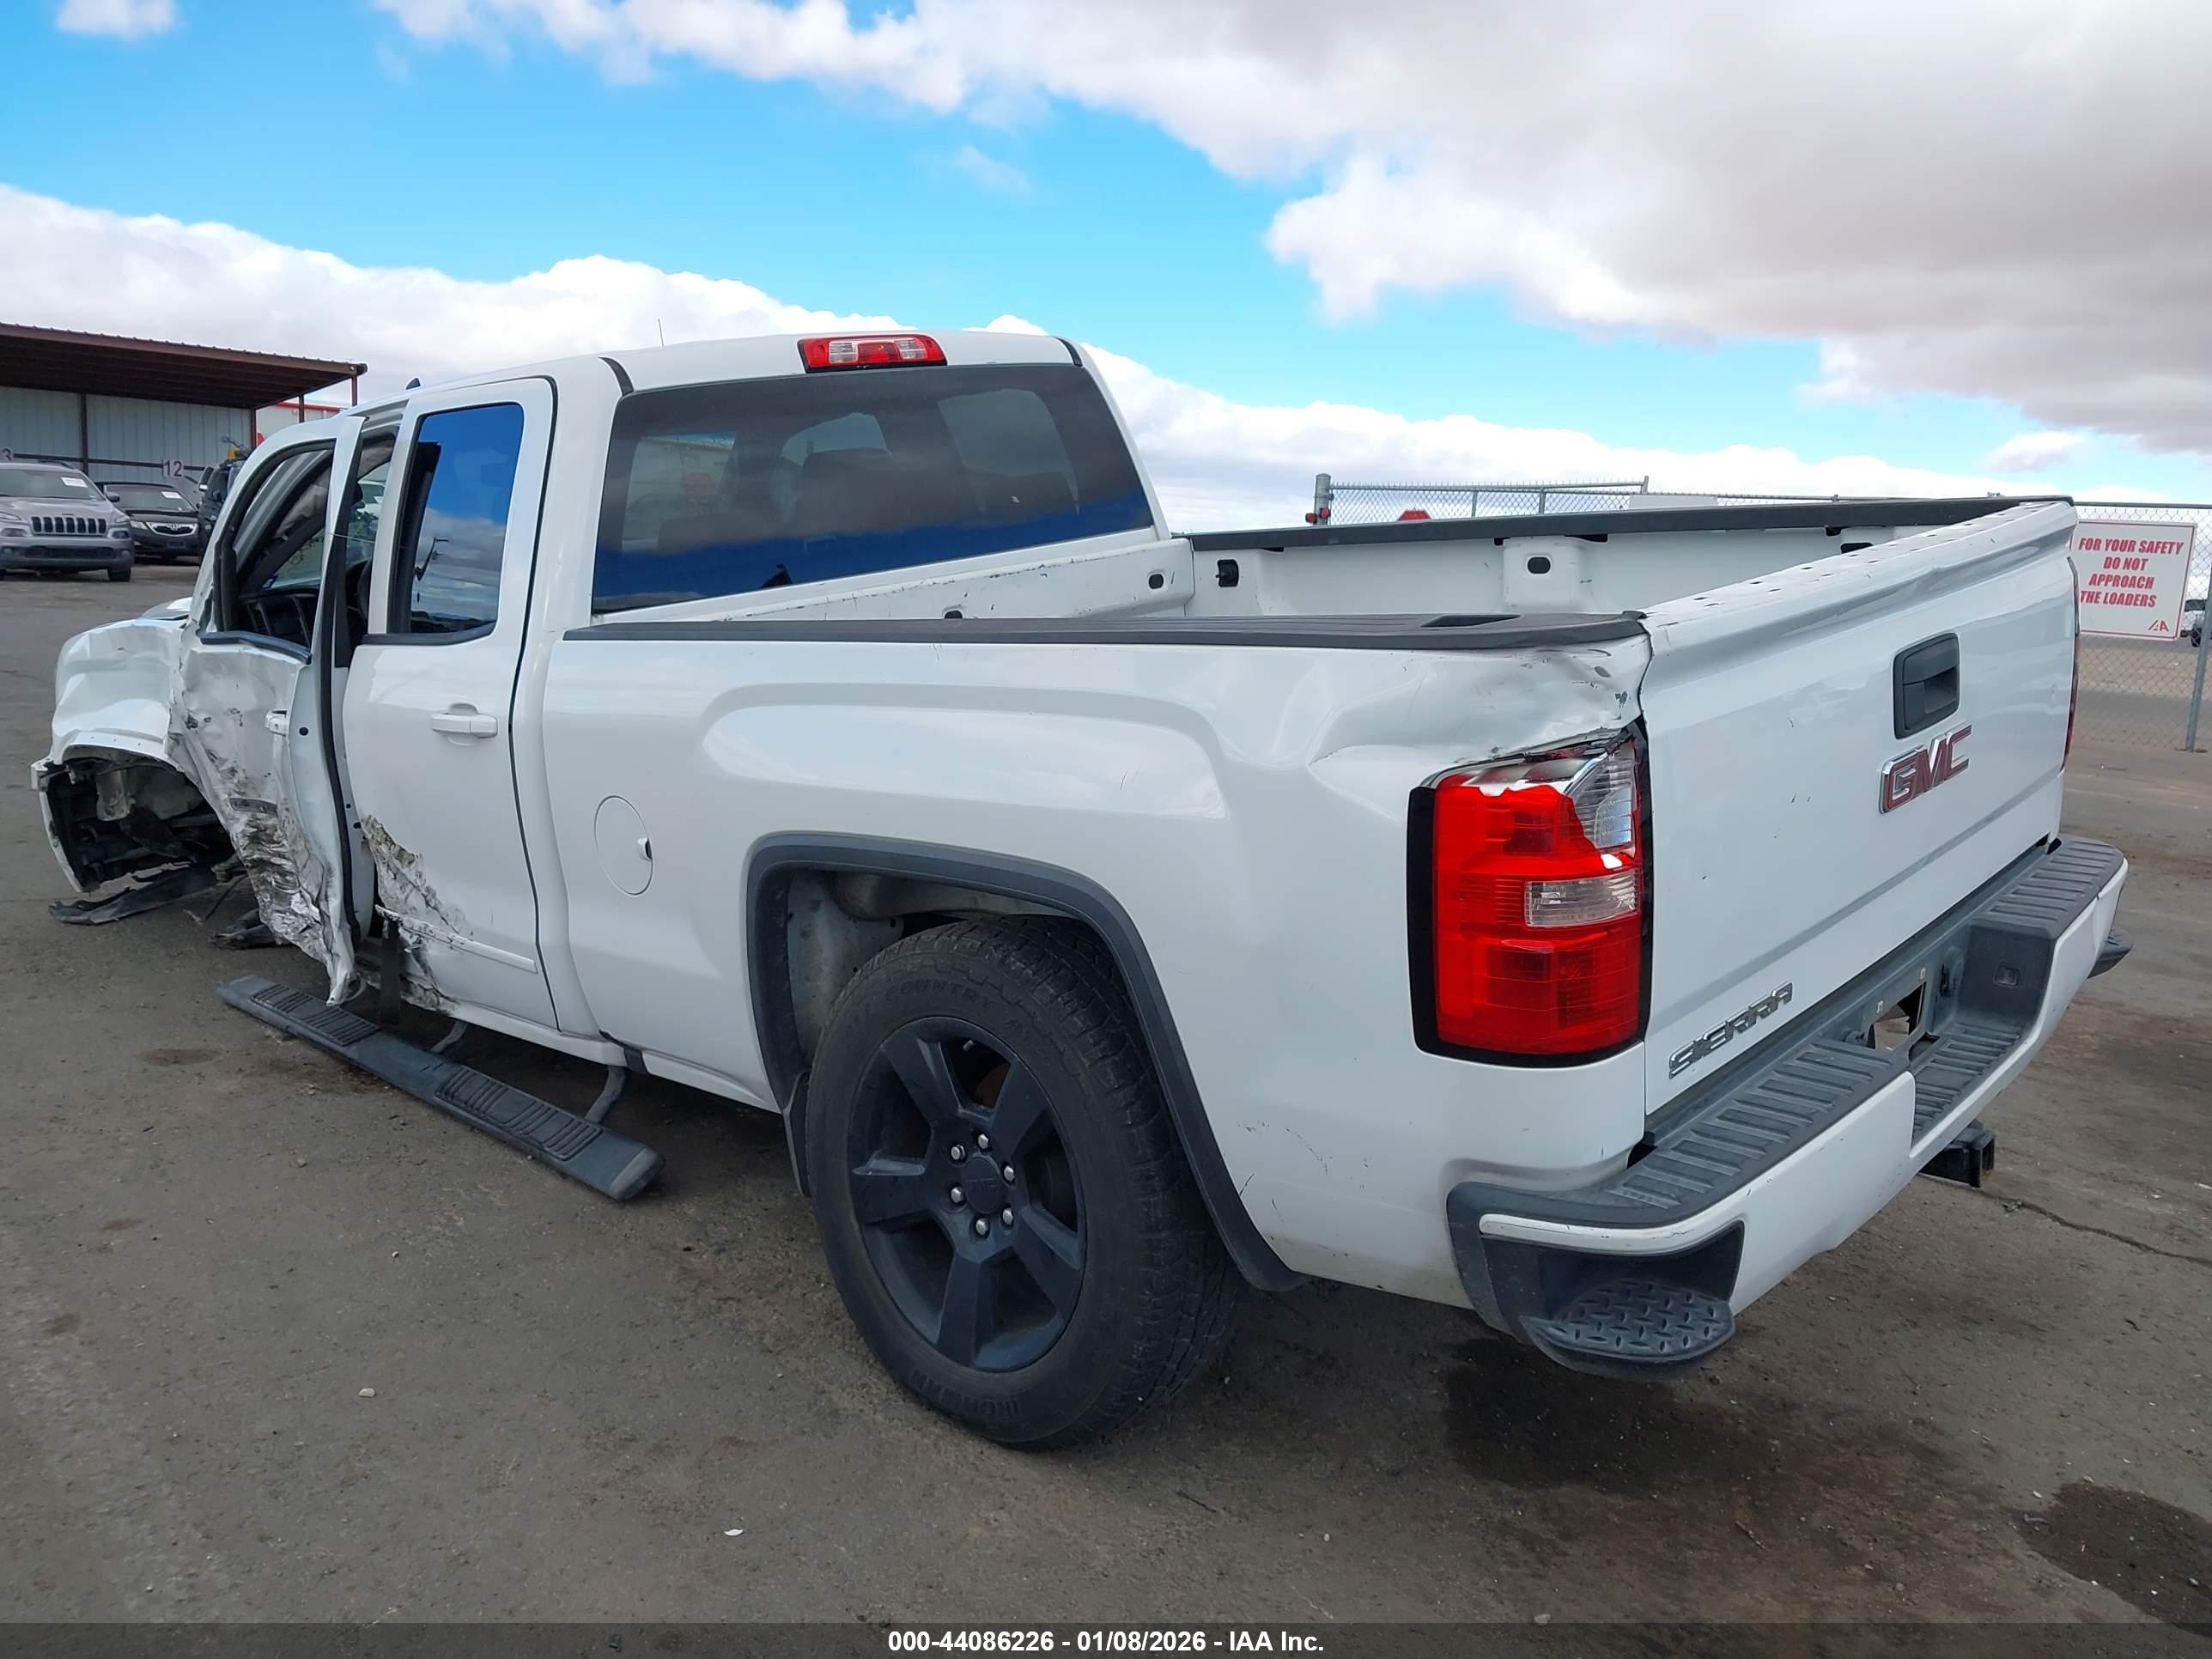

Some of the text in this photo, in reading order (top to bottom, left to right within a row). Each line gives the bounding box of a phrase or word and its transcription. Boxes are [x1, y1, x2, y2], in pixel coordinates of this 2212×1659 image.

[164, 459, 183, 477] 12
[2078, 538, 2184, 555] FOR YOUR SAFETY
[2103, 556, 2148, 571] DO NOT
[2088, 574, 2154, 589] APPROACH
[2080, 591, 2157, 608] THE LOADERS
[1879, 721, 1972, 815] GMC
[1669, 981, 1793, 1079] SIERRA
